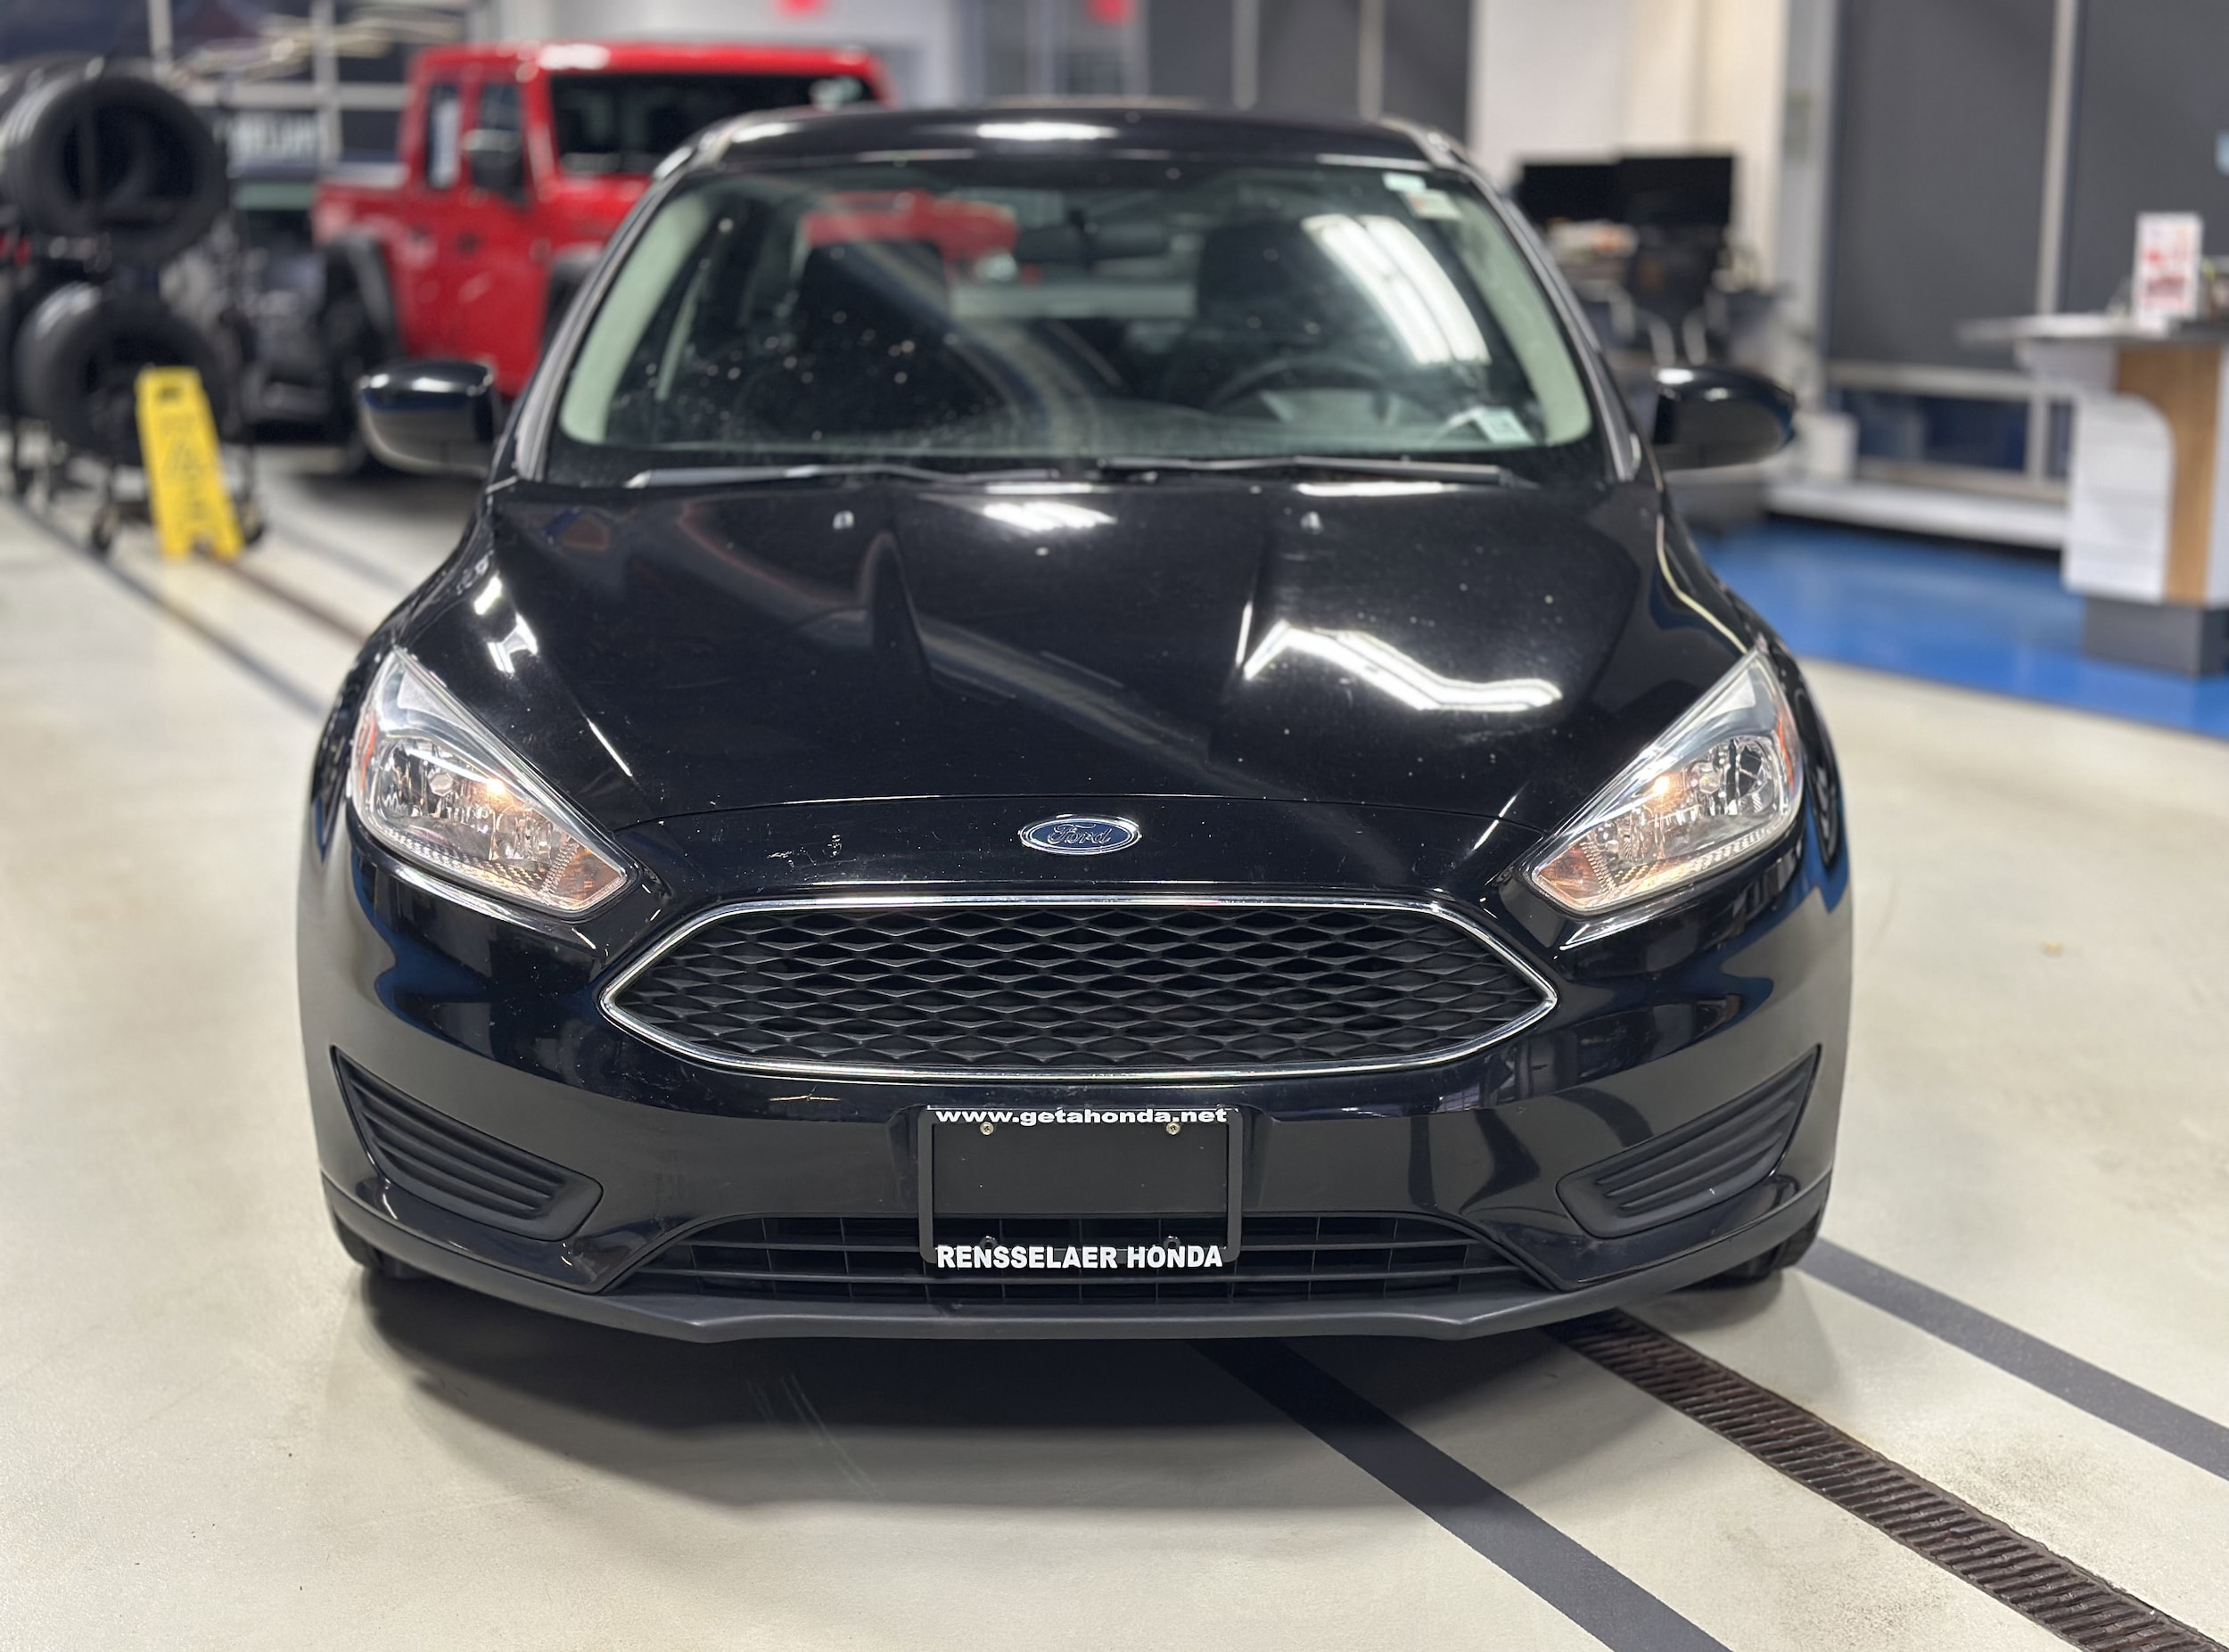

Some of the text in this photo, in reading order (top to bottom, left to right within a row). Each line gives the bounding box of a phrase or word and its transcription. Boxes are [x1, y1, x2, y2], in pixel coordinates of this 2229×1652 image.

[1047, 823, 1113, 844] Ford
[935, 1109, 1227, 1125] www.getahonda.net
[936, 1245, 1223, 1269] RENSSELAER HONDA
